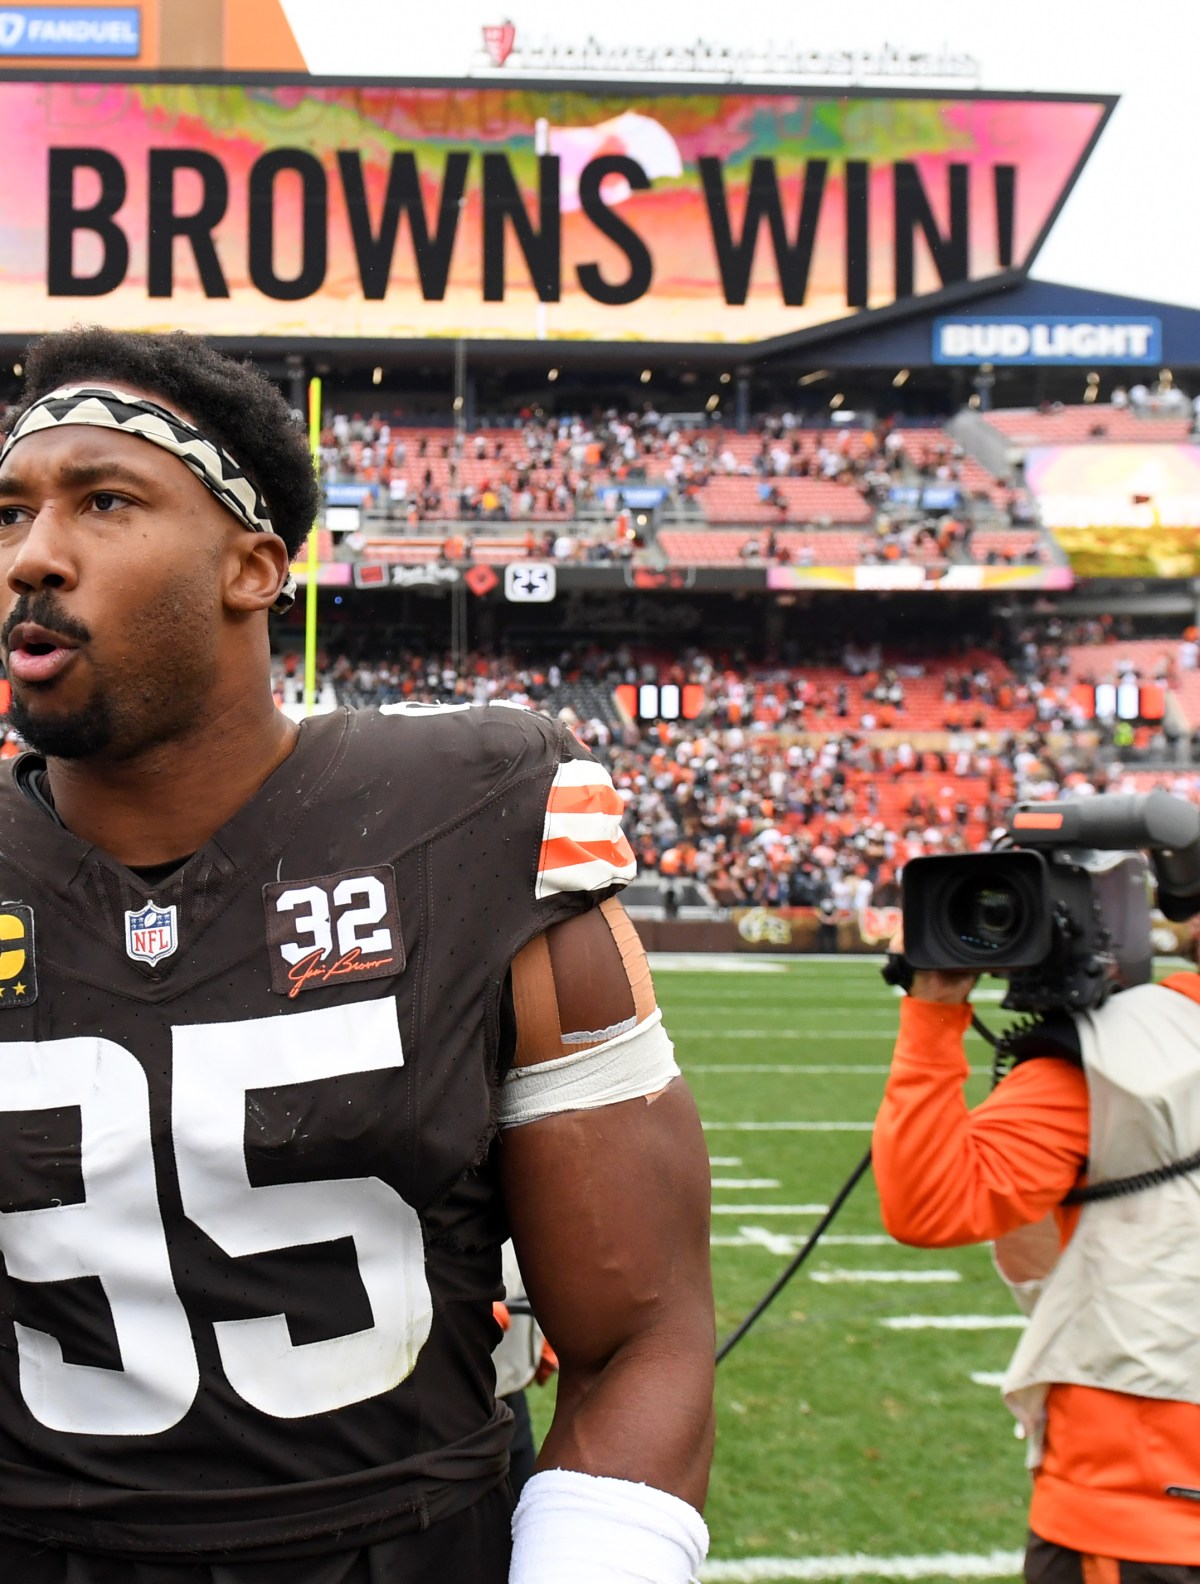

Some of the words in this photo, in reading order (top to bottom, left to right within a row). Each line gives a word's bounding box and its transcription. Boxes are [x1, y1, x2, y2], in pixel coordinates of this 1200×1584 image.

[27, 19, 139, 44] FANDUEL
[46, 146, 655, 306] BROWNS
[700, 154, 1019, 308] WIN!
[939, 322, 1031, 358] BUD
[1031, 322, 1154, 359] LIGHT
[275, 875, 393, 966] 32
[133, 928, 170, 954] NFL
